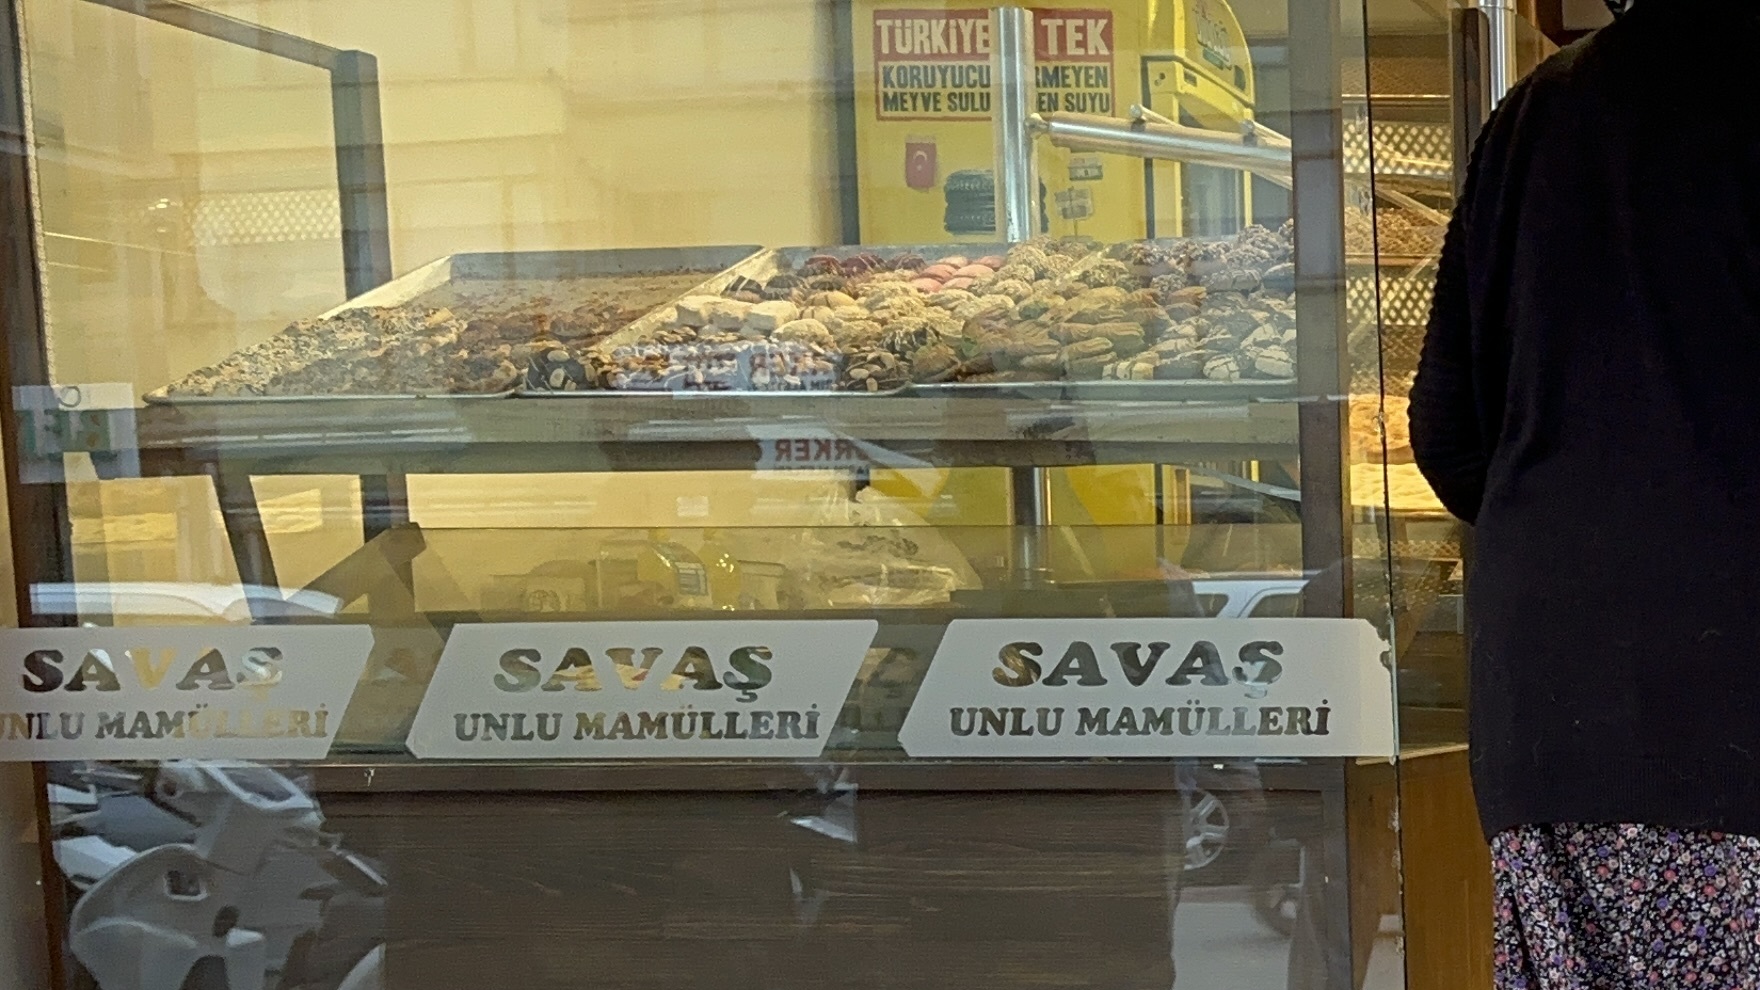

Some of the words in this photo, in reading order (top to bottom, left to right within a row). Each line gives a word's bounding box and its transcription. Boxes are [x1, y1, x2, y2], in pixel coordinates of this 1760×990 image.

[1041, 18, 1110, 55] TEK
[882, 64, 991, 89] KORUYUCU
[883, 91, 942, 112] MEYVE
[947, 91, 991, 112] SULU
[1065, 92, 1110, 113] SUYU
[22, 646, 283, 704] SAVAŞ
[494, 646, 772, 702] SAVAŞ
[992, 640, 1284, 698] SAVAŞ
[0, 712, 85, 740] NLU
[95, 702, 329, 739] MAMÜLLERİ
[454, 712, 563, 741] UNLU
[573, 703, 821, 740] MAMÜLLERİ
[950, 707, 1066, 736] UNLU
[1075, 699, 1330, 736] MAMÜLLERİ
